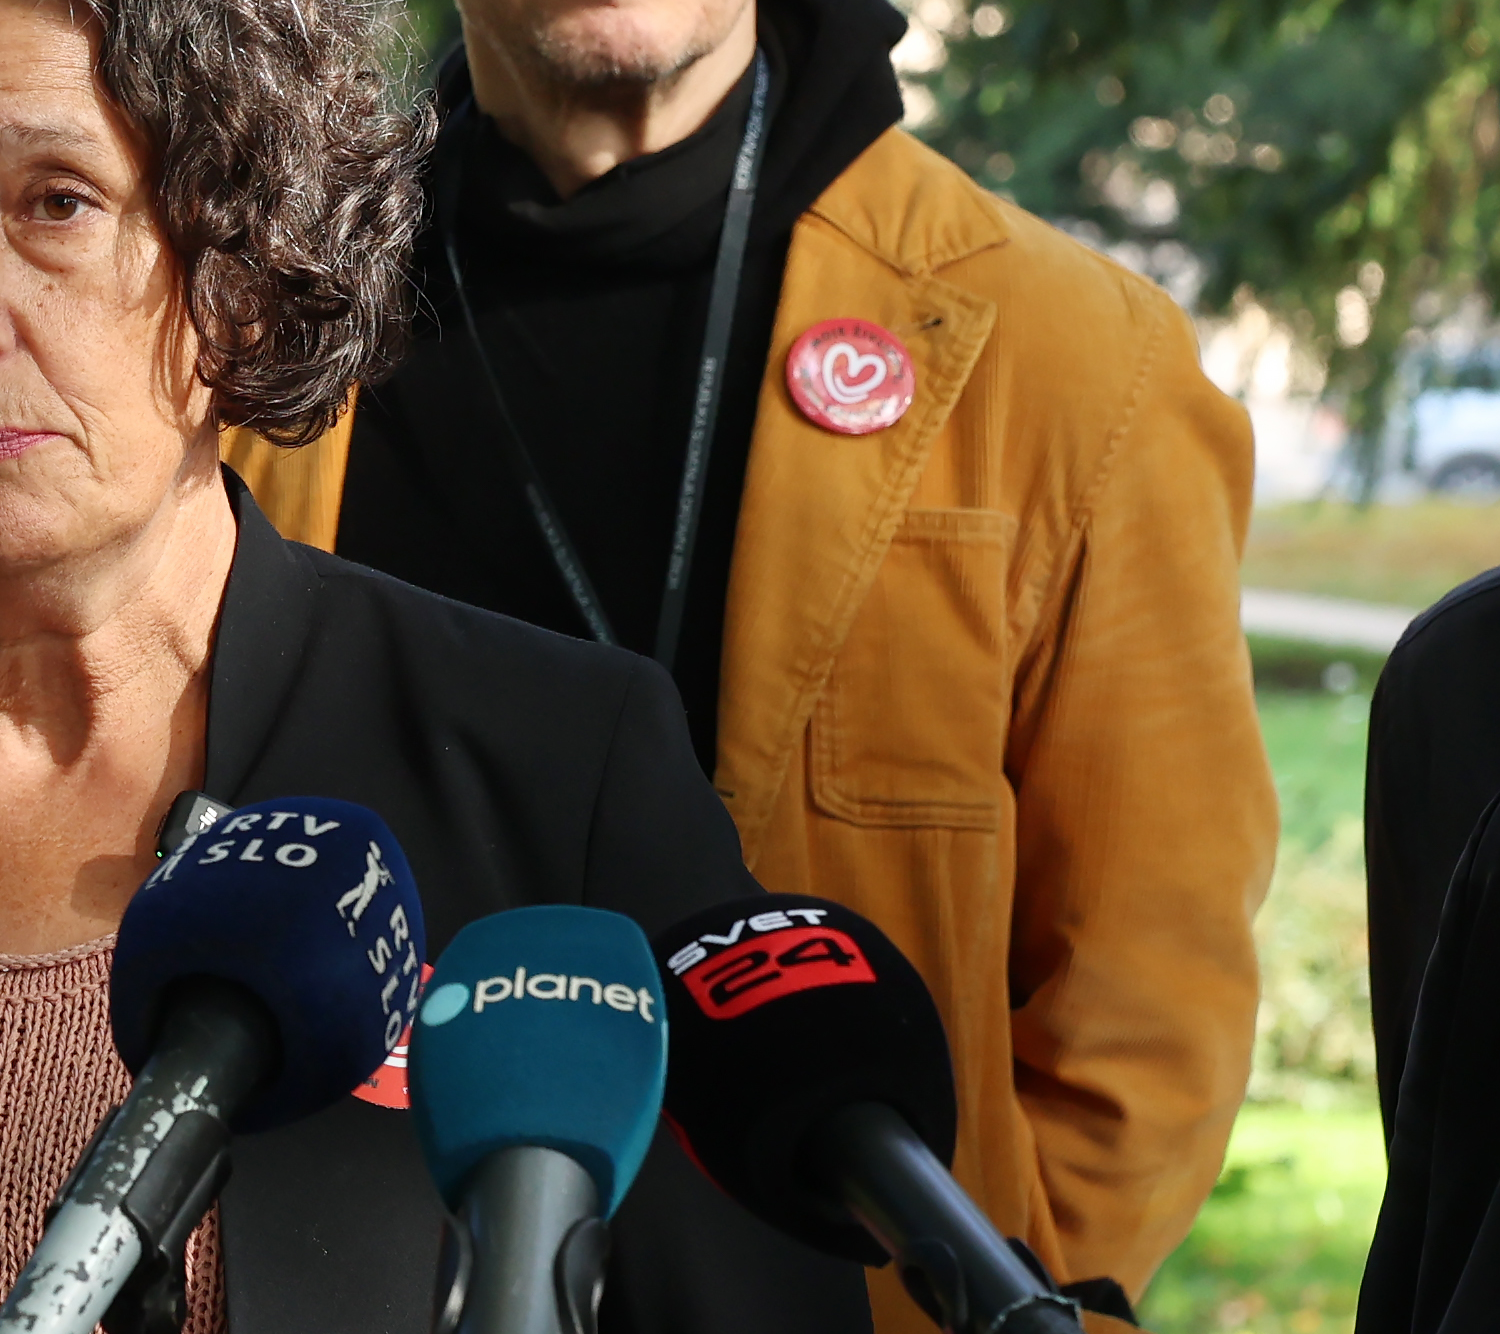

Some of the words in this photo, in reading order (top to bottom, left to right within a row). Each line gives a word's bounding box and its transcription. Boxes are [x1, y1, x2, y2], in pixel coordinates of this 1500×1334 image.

[197, 838, 319, 868] SLO
[224, 811, 341, 837] RTV
[667, 908, 829, 976] SVET
[701, 938, 856, 1007] 24
[367, 936, 403, 1053] SLO
[473, 966, 656, 1024] planet
